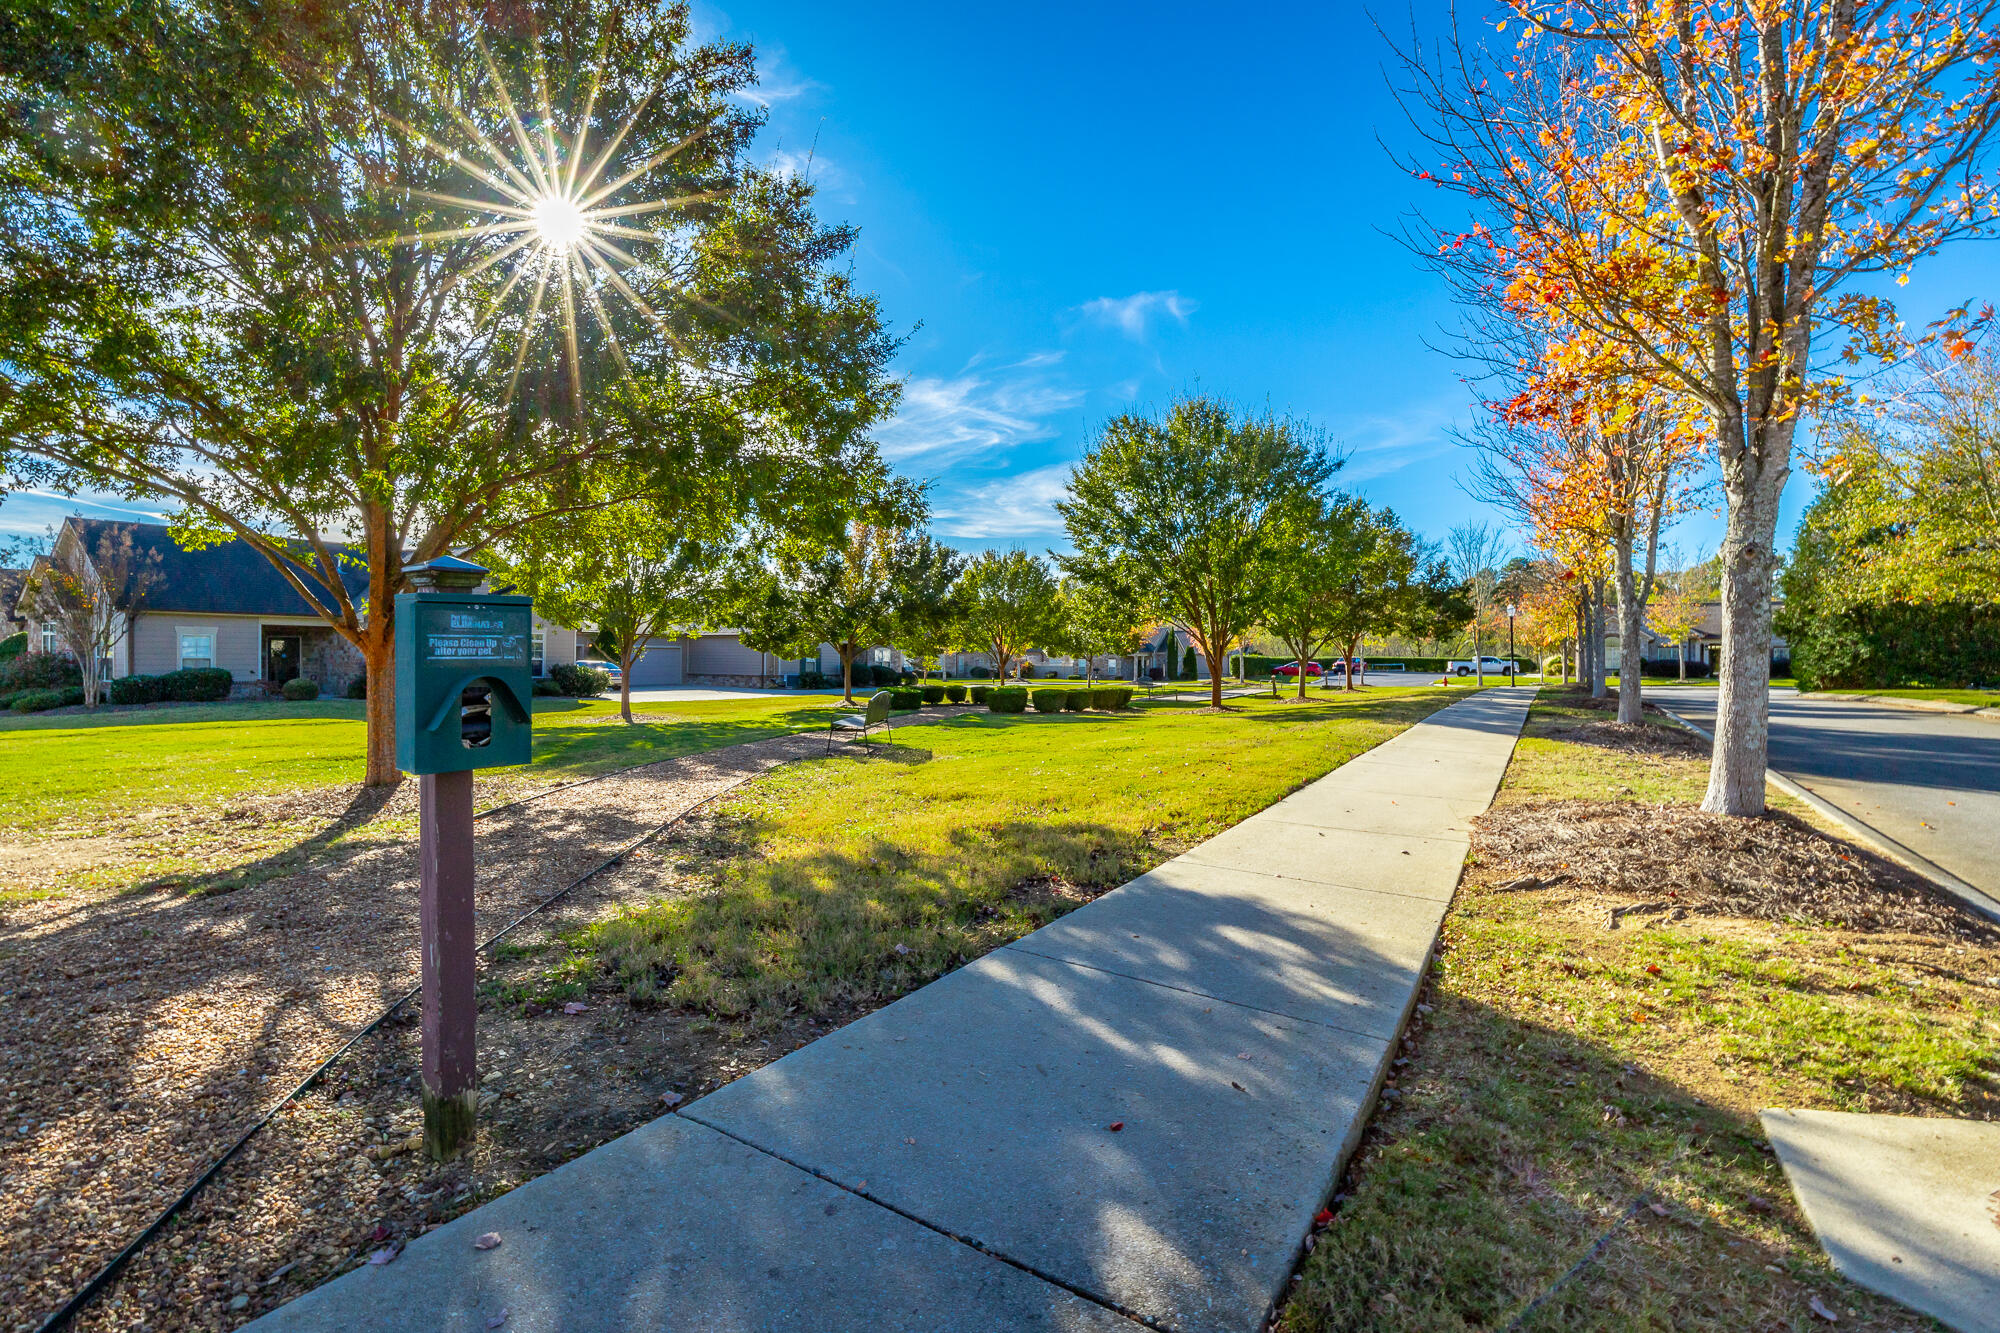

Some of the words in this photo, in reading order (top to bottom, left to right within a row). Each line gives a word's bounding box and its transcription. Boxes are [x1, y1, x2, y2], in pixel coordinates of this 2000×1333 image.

[429, 638, 458, 647] Please
[460, 638, 485, 647] Clean
[486, 638, 497, 648] Up
[434, 647, 456, 655] after
[457, 648, 476, 656] your
